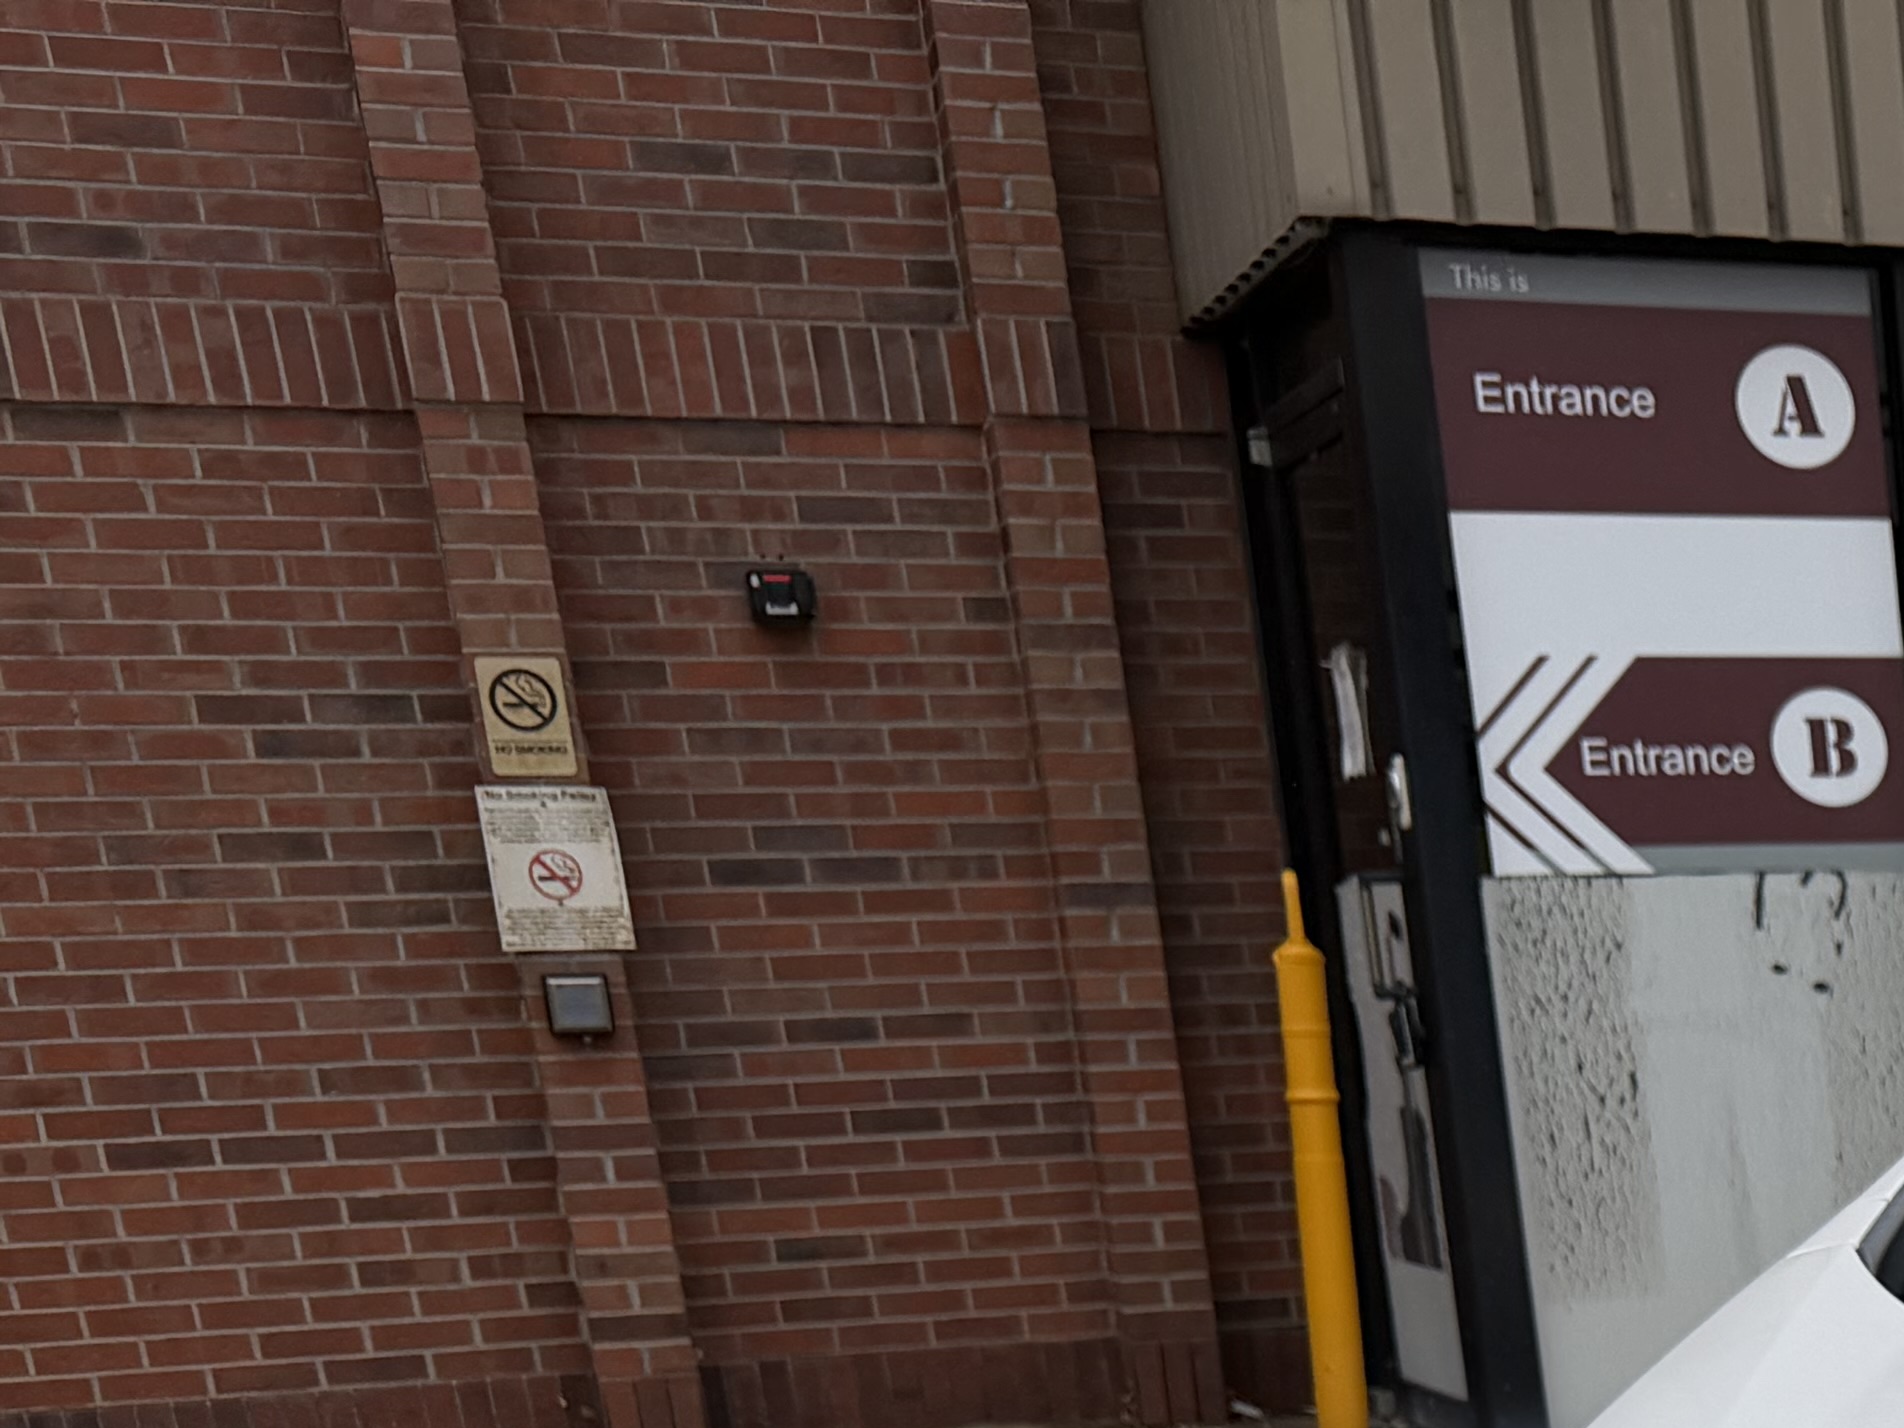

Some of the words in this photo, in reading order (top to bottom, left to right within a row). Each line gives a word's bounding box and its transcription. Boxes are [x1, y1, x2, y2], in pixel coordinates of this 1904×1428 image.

[1448, 263, 1501, 292] This
[1507, 265, 1529, 293] is
[1474, 372, 1656, 420] Entrance
[1772, 375, 1825, 438] A
[1580, 737, 1756, 777] Entrance
[1803, 716, 1859, 778] B
